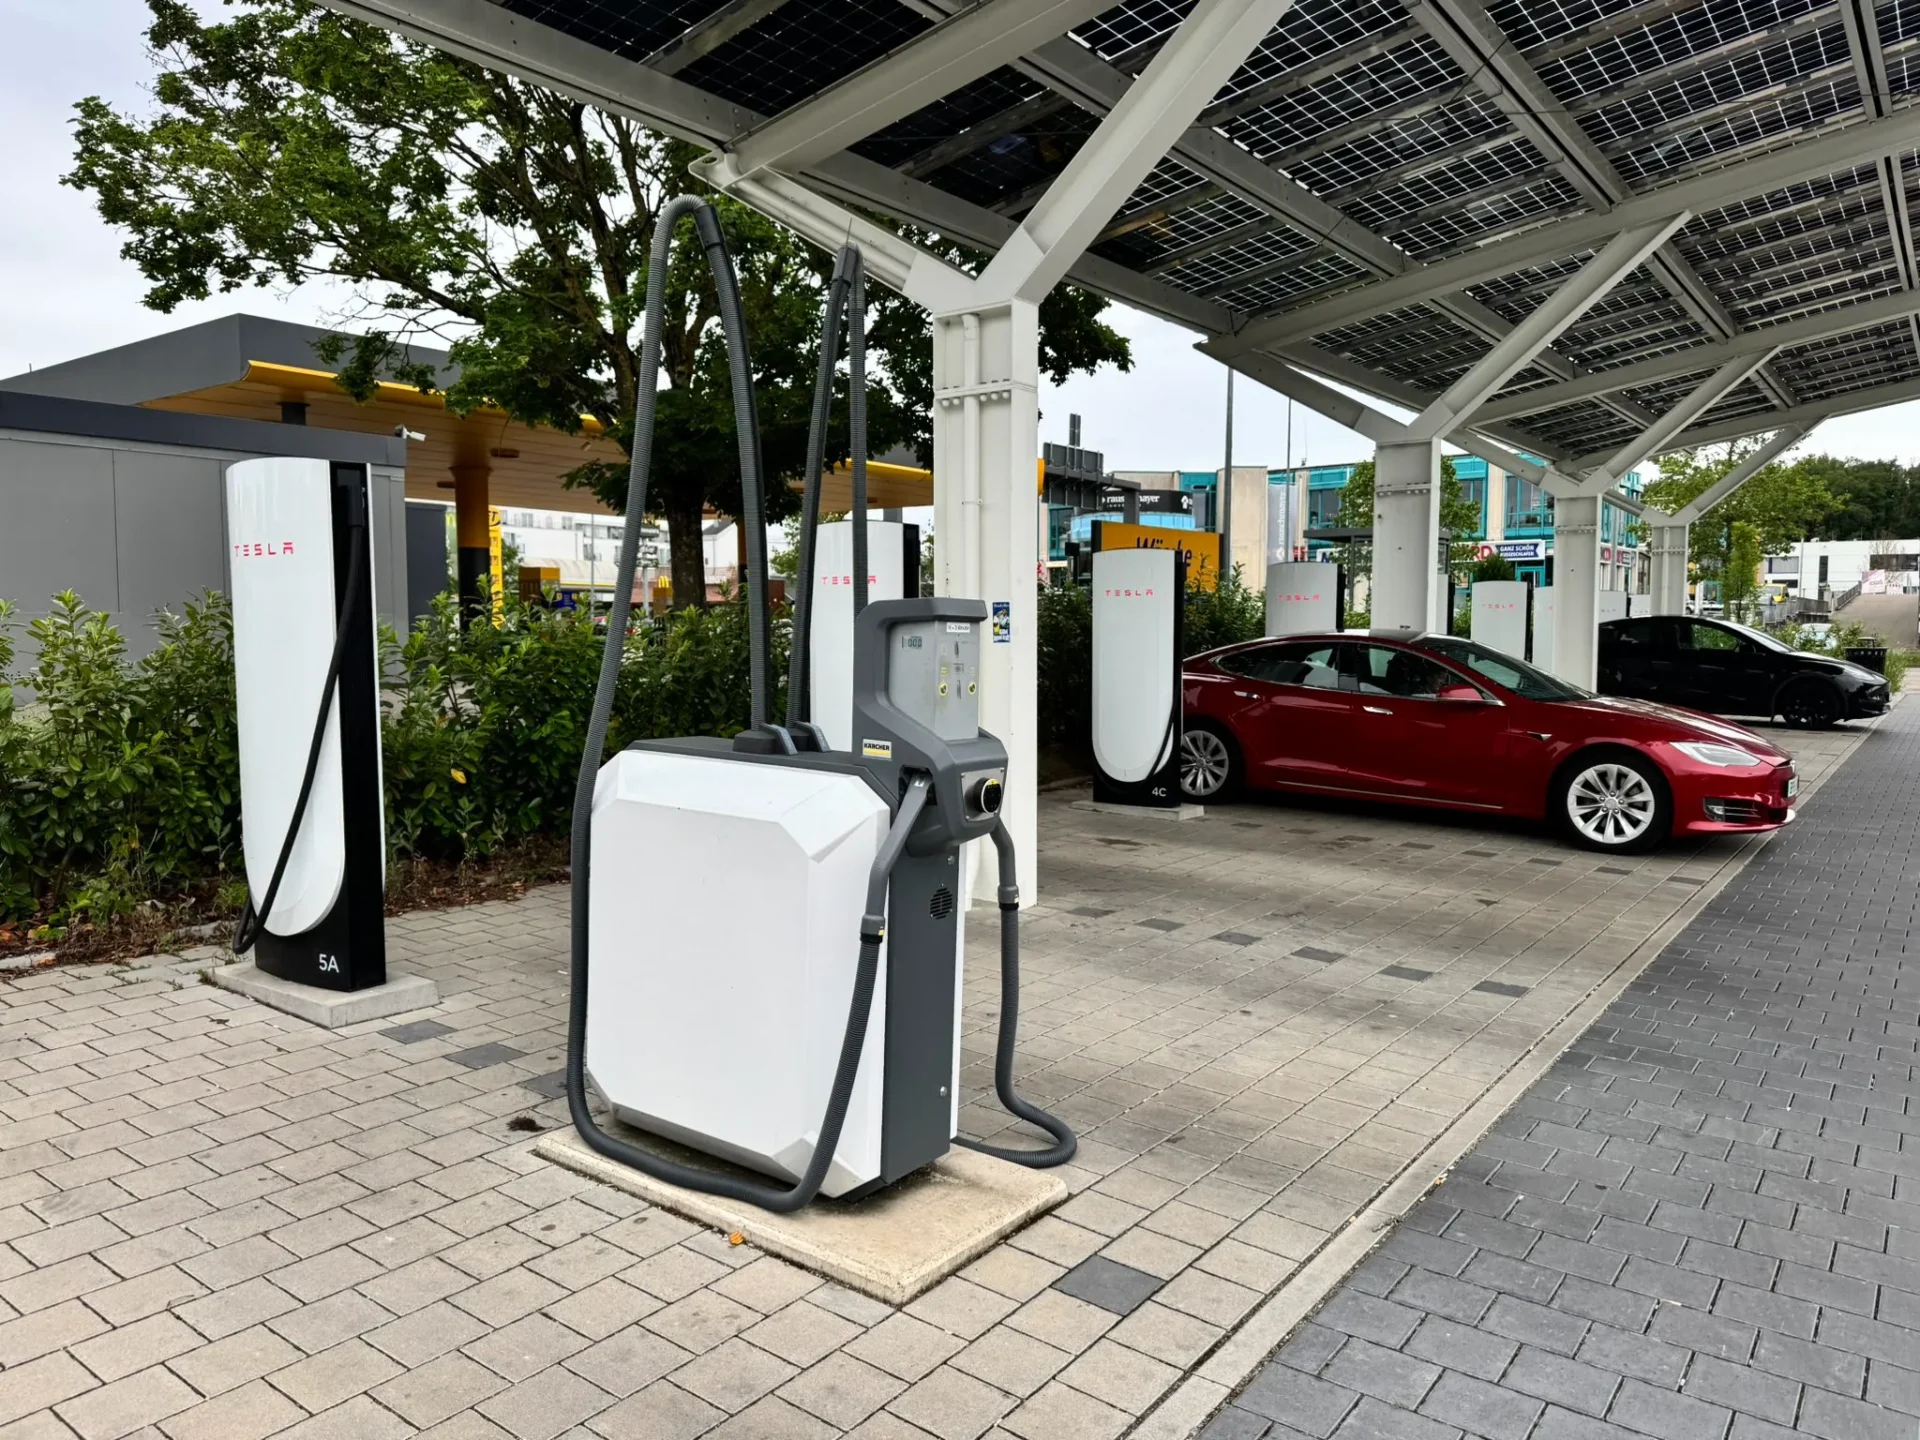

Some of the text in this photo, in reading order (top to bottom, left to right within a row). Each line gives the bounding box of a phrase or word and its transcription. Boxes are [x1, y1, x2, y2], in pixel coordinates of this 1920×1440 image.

[234, 541, 294, 558] TESLA
[821, 575, 877, 585] TESA
[1105, 588, 1154, 597] TESLA
[1152, 787, 1167, 797] 4C
[319, 953, 340, 973] 5A
